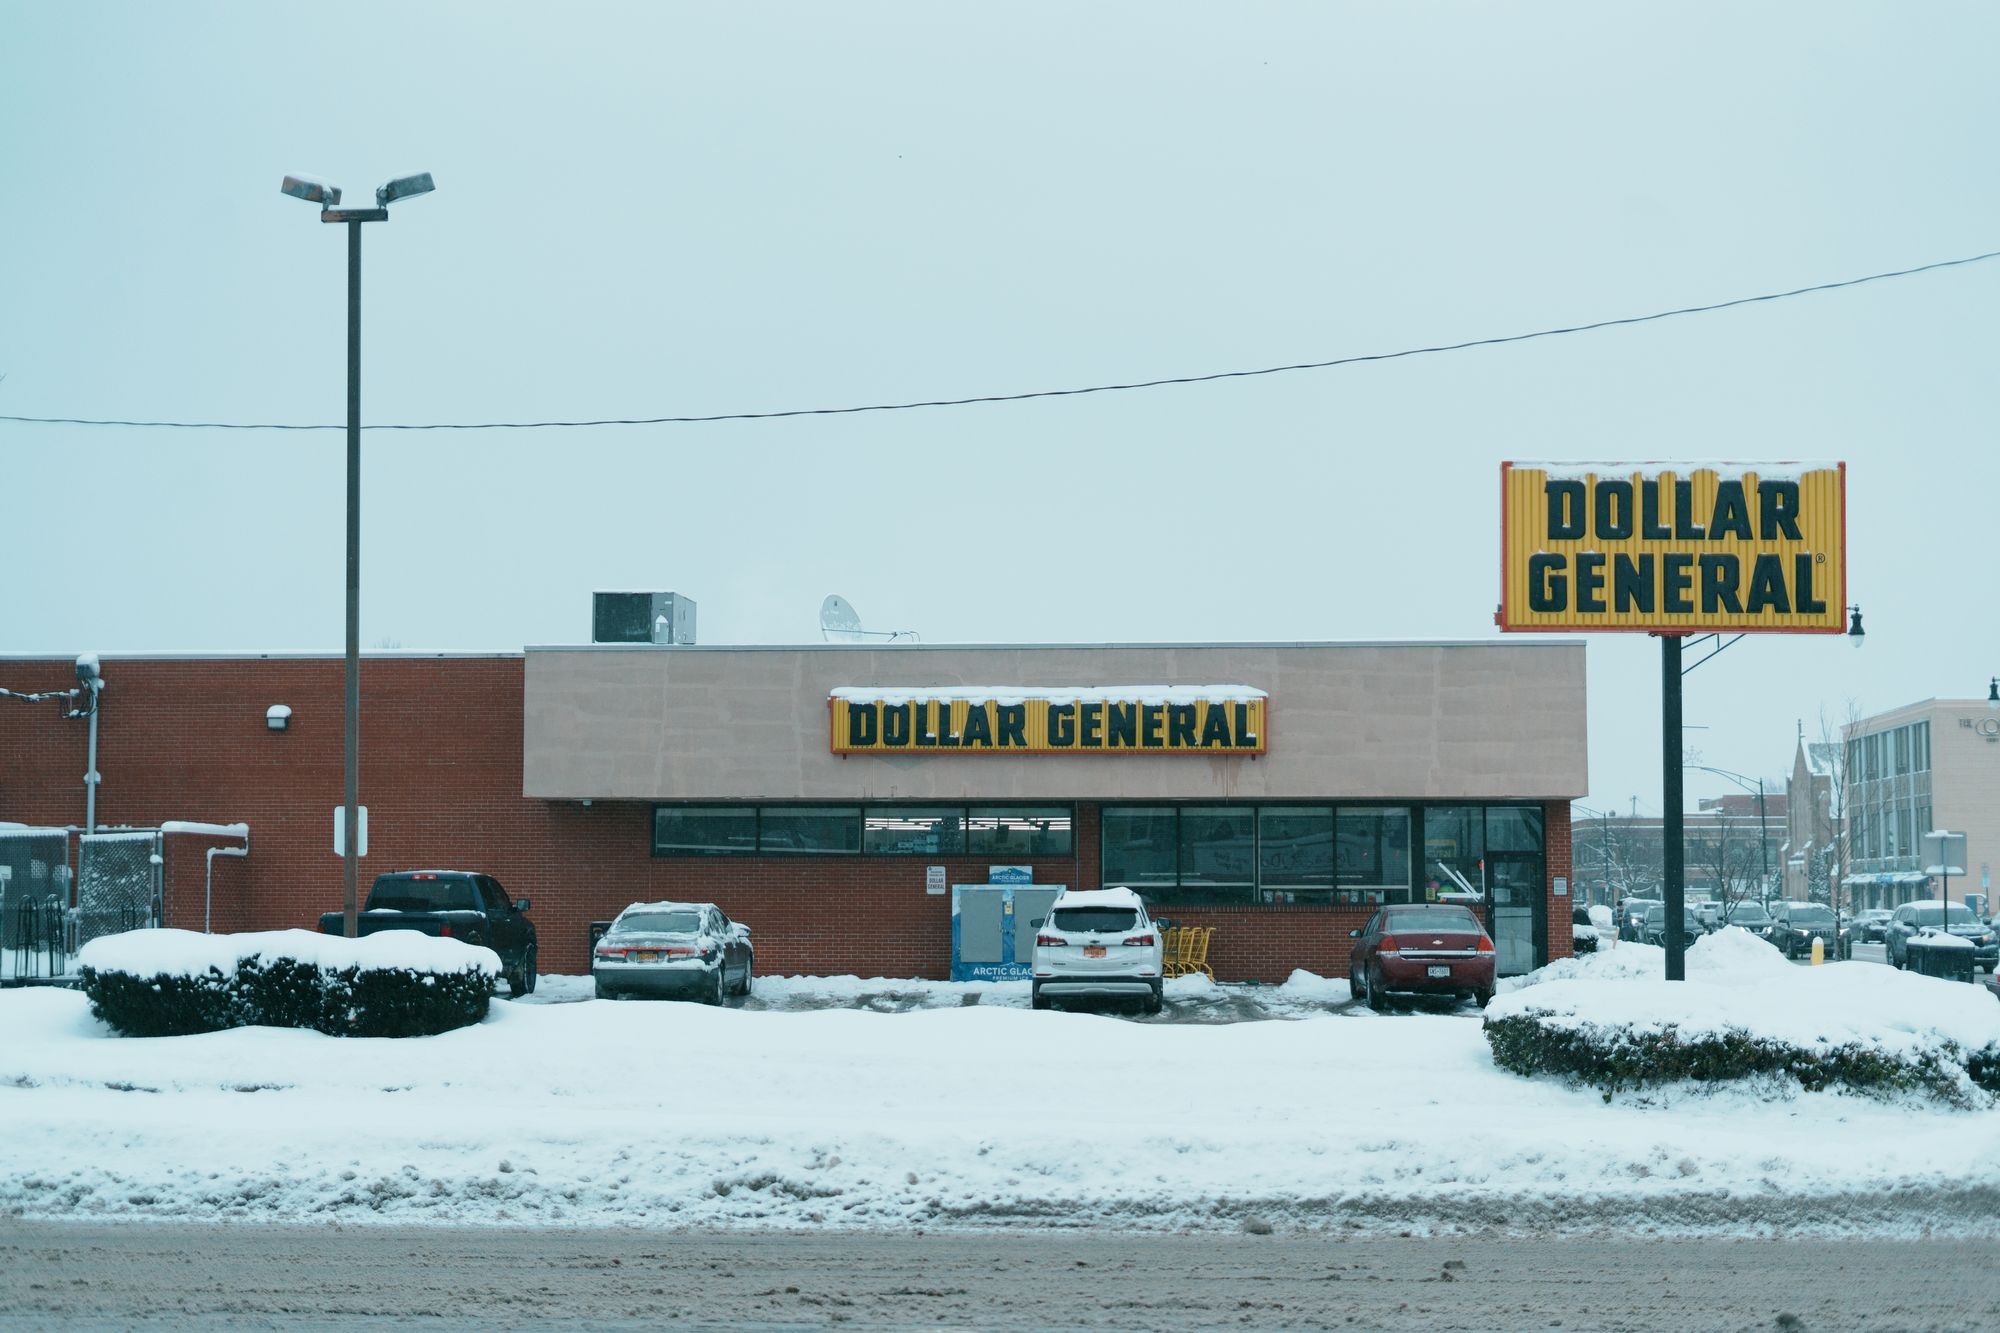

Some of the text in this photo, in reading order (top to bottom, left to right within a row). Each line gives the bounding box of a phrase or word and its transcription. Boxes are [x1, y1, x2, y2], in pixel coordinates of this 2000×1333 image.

[1545, 480, 1803, 541] DOLLAR
[848, 703, 1029, 747] DOLLAR
[973, 967, 1007, 976] ARCTIC
